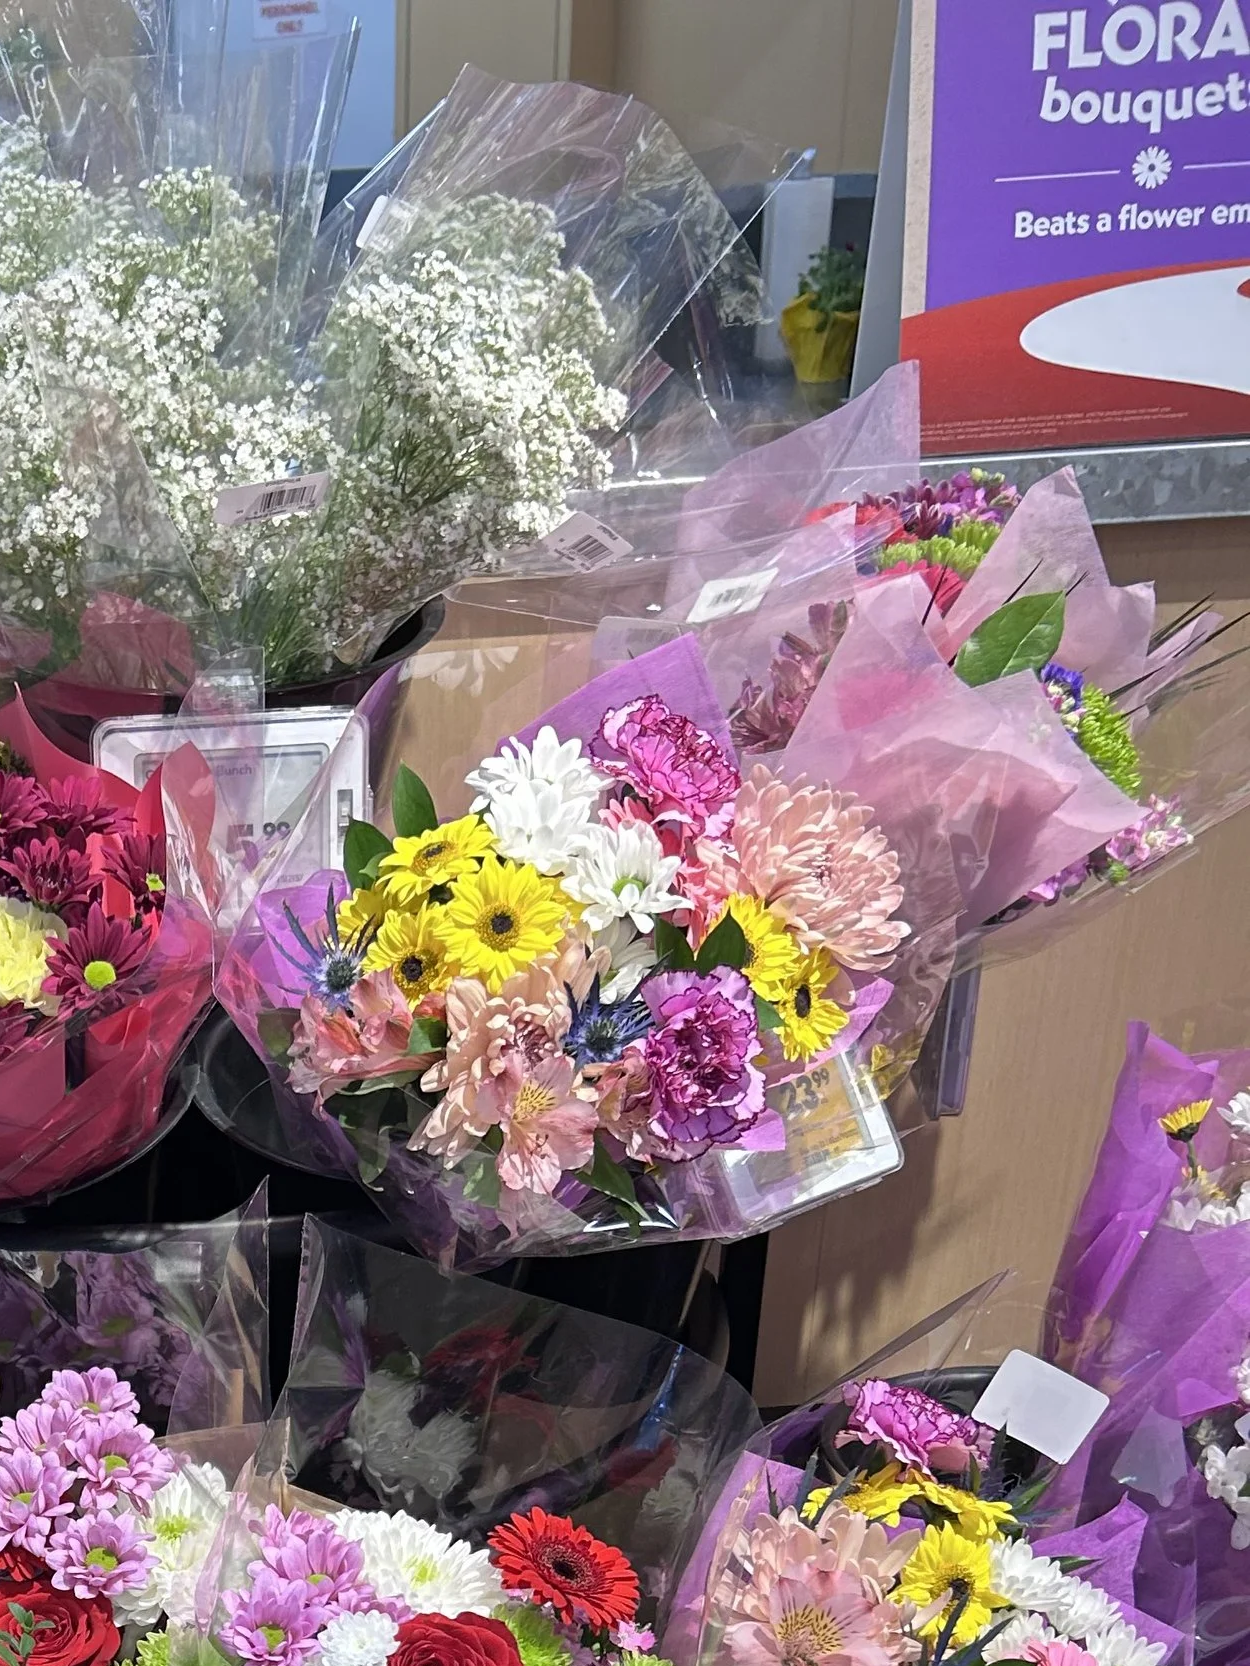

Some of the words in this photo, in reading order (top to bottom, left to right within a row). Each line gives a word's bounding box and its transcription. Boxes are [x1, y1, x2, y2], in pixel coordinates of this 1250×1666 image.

[1040, 72, 1250, 134] bouquet
[1014, 210, 1090, 238] Beats
[1096, 212, 1112, 233] a
[1118, 203, 1205, 231] flower
